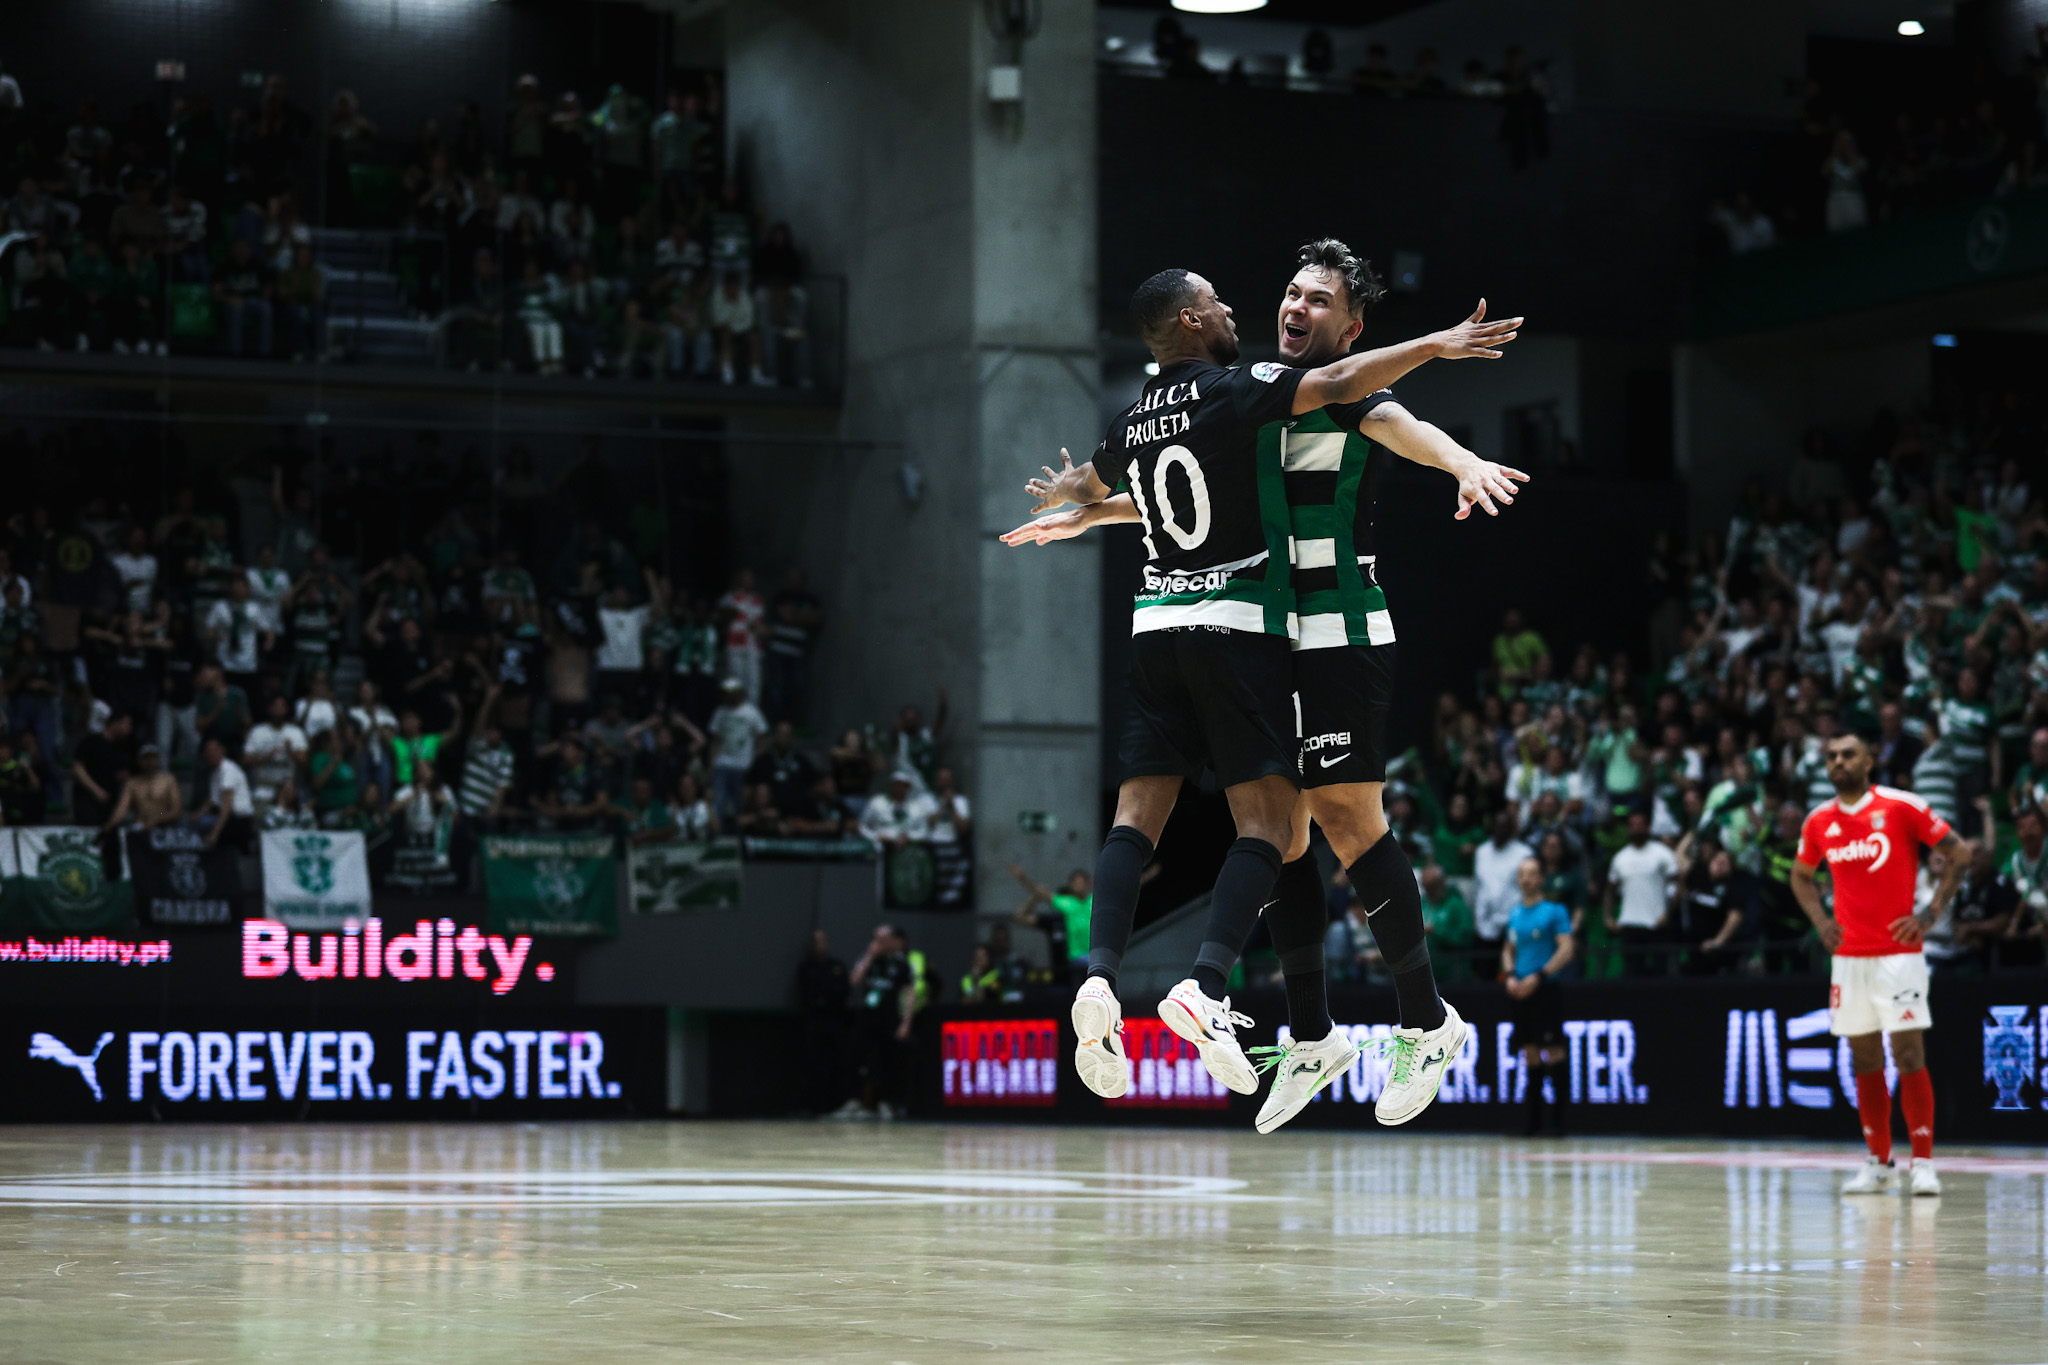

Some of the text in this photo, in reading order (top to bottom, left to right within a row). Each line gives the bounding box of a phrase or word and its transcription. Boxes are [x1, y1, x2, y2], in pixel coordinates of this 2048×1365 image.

[1125, 411, 1190, 449] PAULETA
[1127, 444, 1212, 561] 10
[241, 916, 556, 995] Buildity.
[127, 1030, 622, 1102] FOREVER. FASTER.
